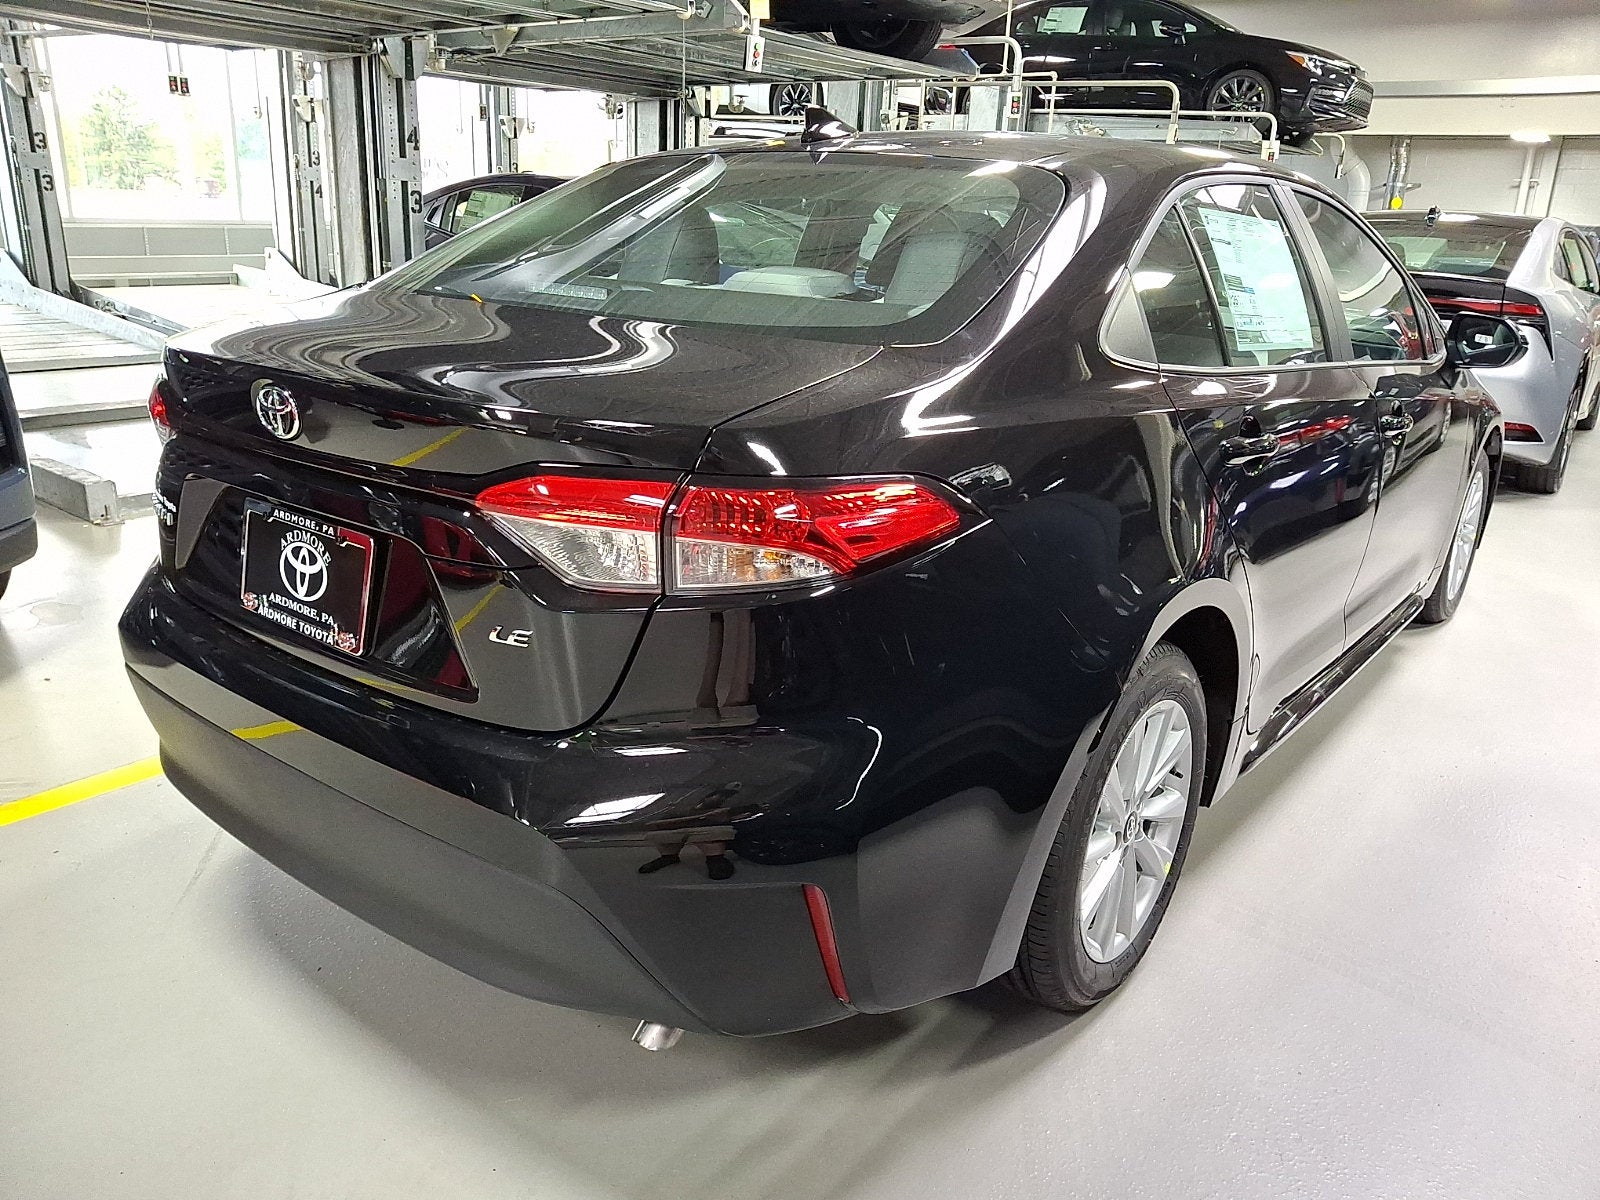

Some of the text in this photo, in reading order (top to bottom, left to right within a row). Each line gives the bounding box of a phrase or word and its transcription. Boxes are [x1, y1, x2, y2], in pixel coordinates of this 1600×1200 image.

[34, 131, 48, 150] 3
[407, 126, 420, 151] 4
[312, 150, 321, 166] 3
[42, 174, 54, 191] 3
[315, 183, 323, 199] 4
[410, 190, 423, 214] 3
[273, 509, 335, 536] ARDMORE, PA
[280, 529, 332, 567] ARDMORE
[268, 592, 335, 626] ARDMORE, PA
[257, 604, 334, 646] ARDMORE TOYOTA
[488, 625, 533, 648] LE
